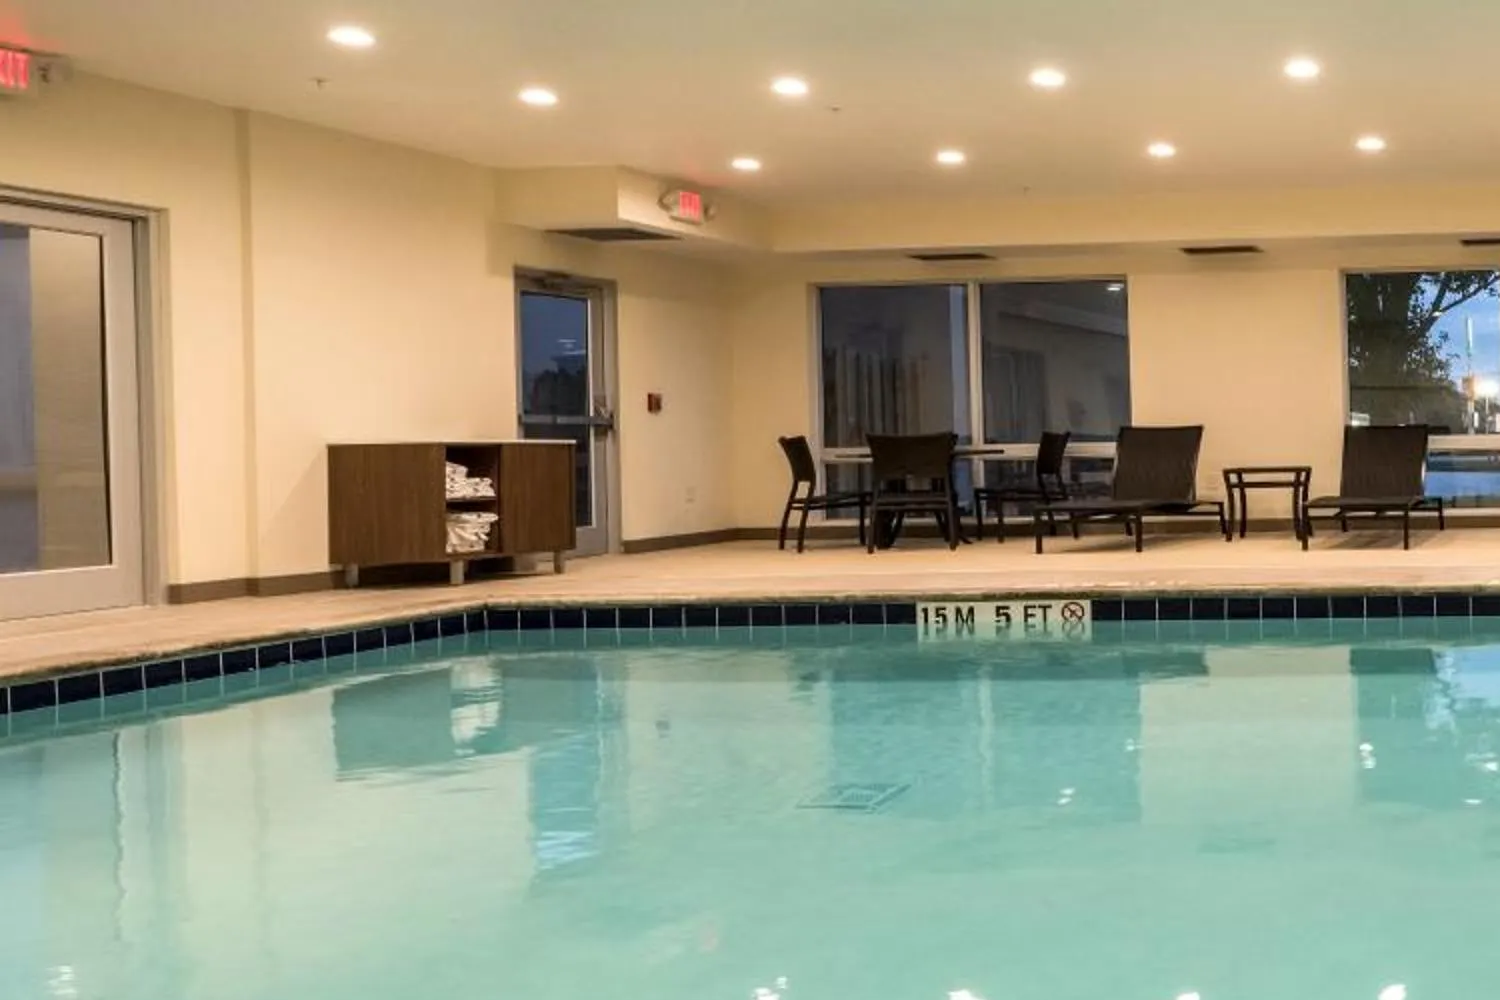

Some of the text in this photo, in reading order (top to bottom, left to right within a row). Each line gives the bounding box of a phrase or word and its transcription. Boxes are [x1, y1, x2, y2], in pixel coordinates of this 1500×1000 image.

[0, 49, 29, 90] IT
[994, 605, 1012, 624] 5
[1023, 604, 1053, 624] FT
